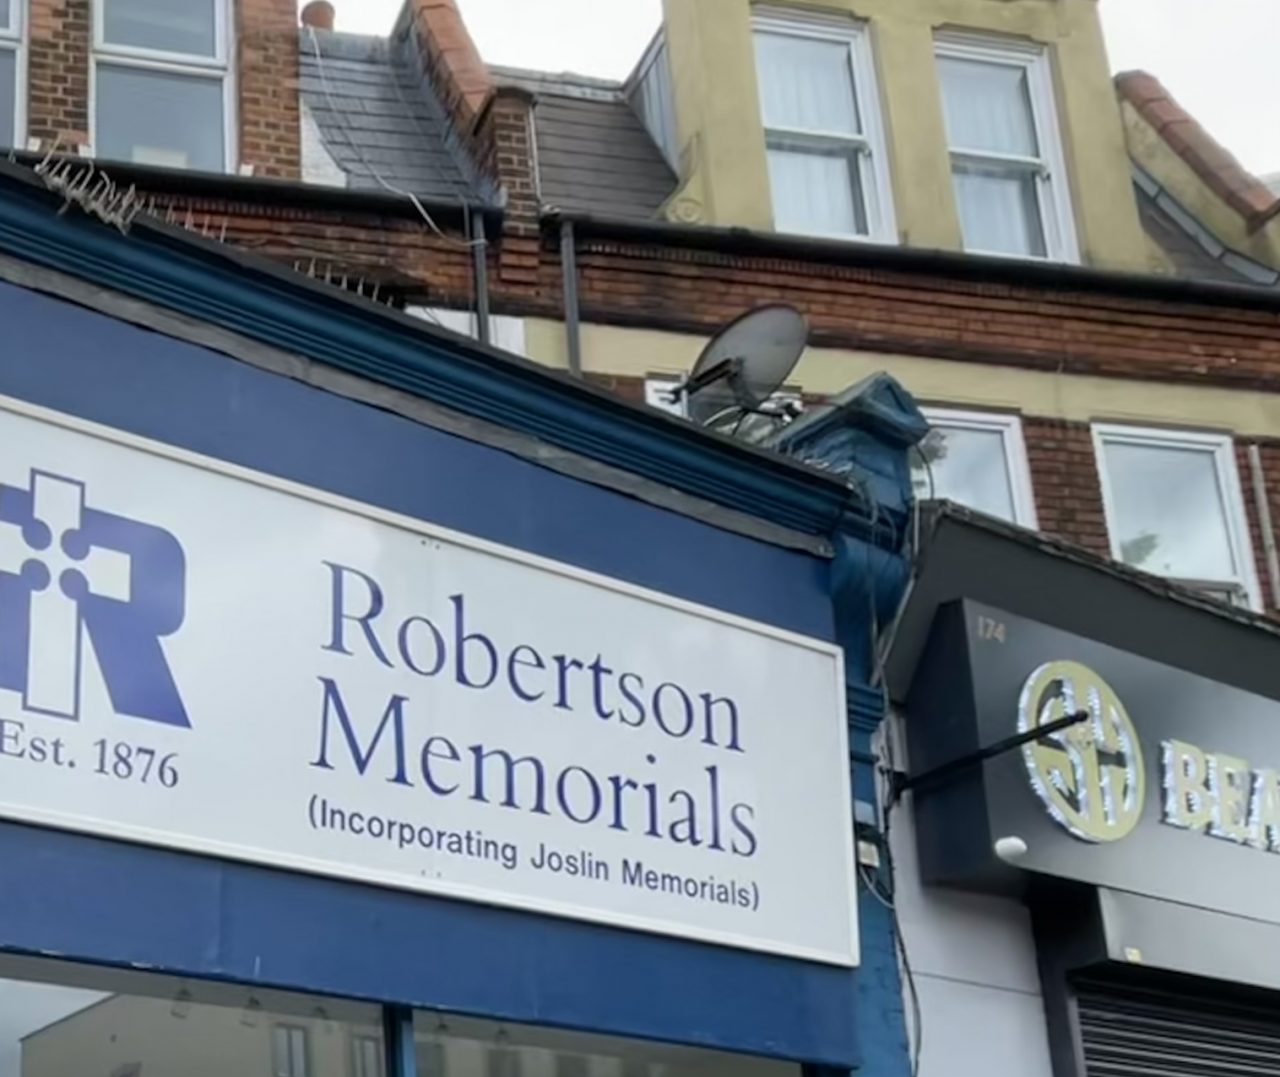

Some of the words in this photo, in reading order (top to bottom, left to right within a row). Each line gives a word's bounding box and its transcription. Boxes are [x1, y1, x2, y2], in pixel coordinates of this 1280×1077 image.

[321, 558, 744, 754] Robertson
[978, 616, 1006, 643] 174
[93, 737, 179, 789] 1876
[310, 674, 759, 858] Memorials
[308, 795, 518, 870] (Incorporating
[530, 842, 609, 883] Joslin
[621, 858, 760, 912] Memorials)
